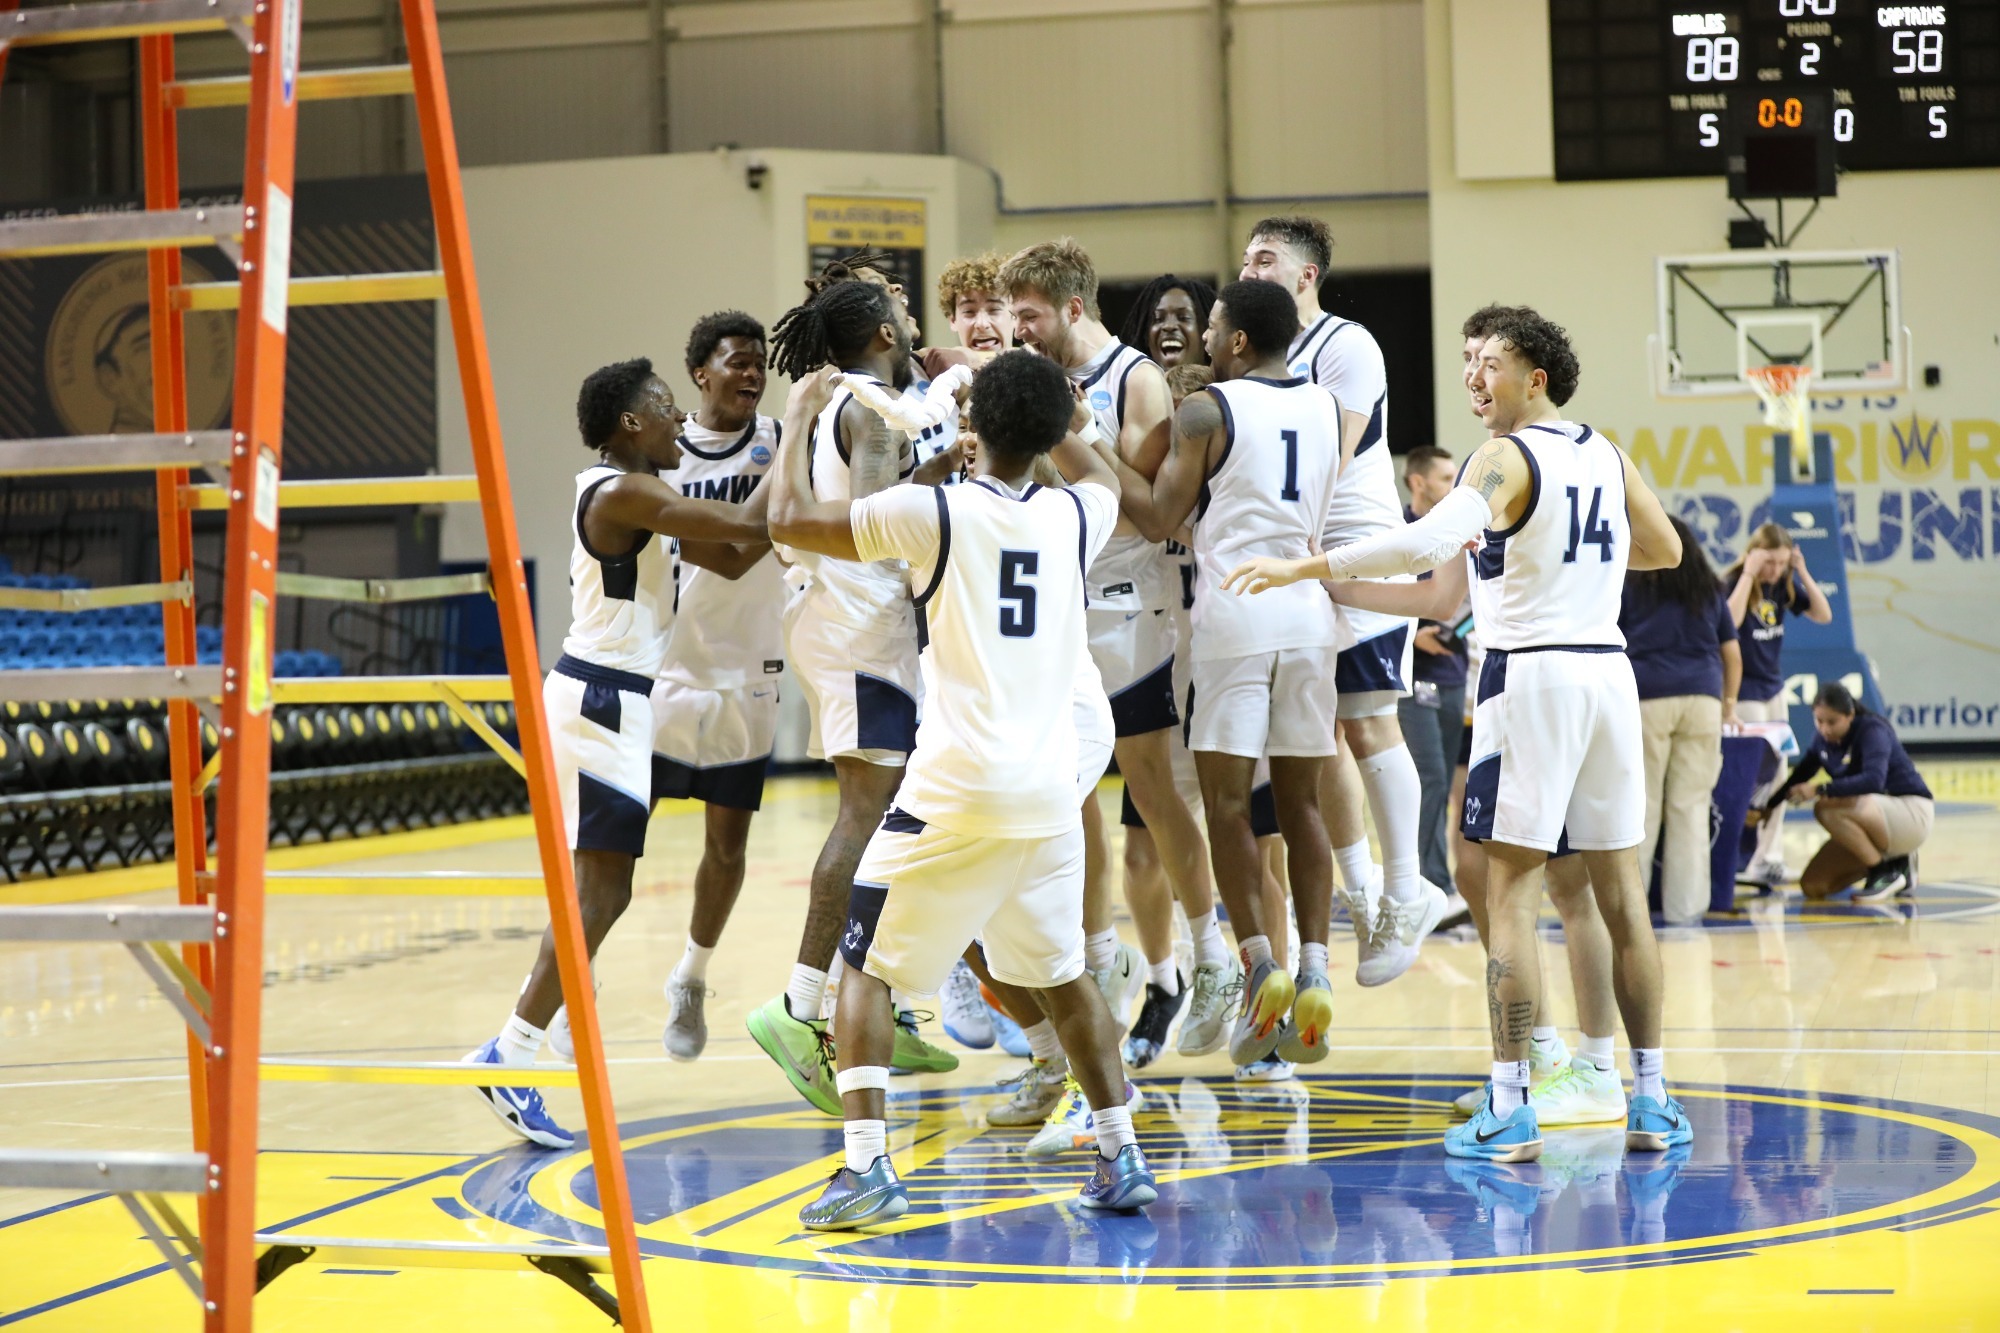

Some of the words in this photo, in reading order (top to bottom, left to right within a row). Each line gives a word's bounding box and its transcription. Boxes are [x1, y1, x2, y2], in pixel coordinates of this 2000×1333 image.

[1786, 22, 1832, 37] PERIOD
[1877, 6, 1946, 27] CAPTAINS
[1686, 36, 1739, 82] 88
[1800, 42, 1820, 75] 2
[1892, 30, 1943, 73] 58
[1919, 85, 1957, 101] FOULS
[1699, 113, 1719, 147] 5
[1834, 108, 1854, 142] 0
[1928, 105, 1947, 139] 5
[1281, 429, 1301, 501] 1
[1562, 485, 1616, 564] 14
[998, 548, 1040, 639] 5
